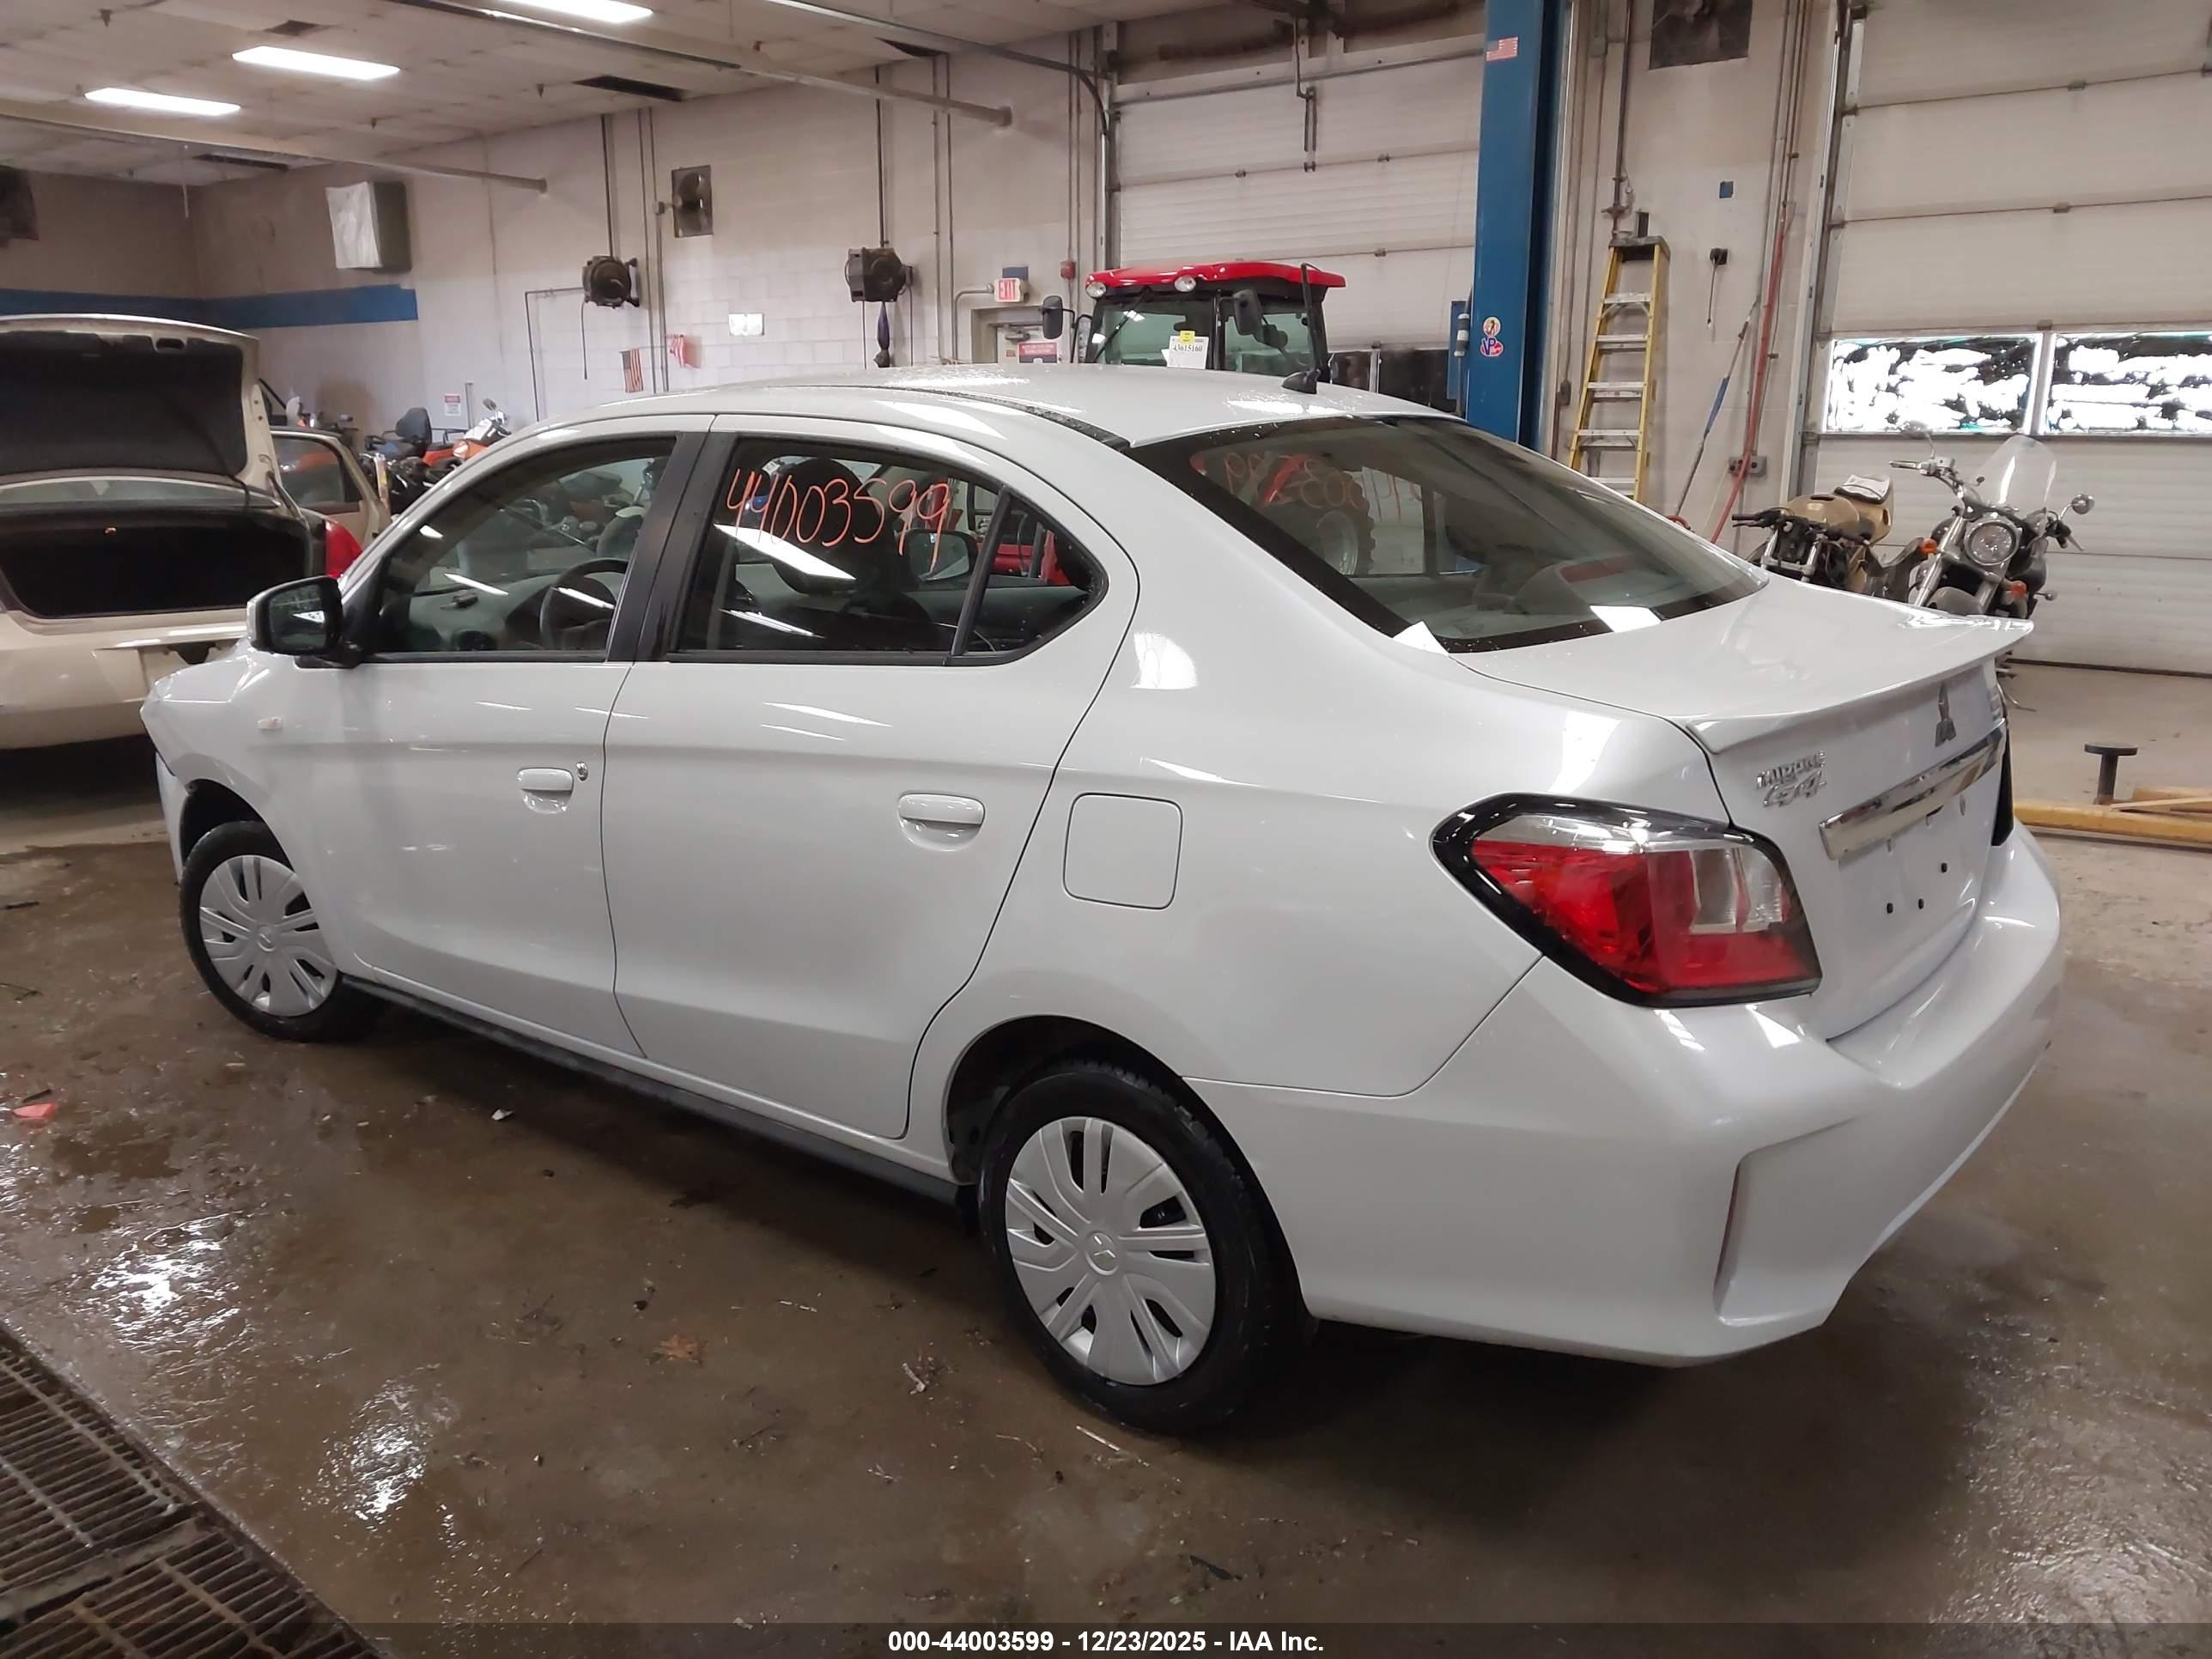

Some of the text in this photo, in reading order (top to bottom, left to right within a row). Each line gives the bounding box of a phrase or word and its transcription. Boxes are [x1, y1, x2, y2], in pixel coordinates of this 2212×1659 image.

[999, 280, 1017, 300] EXIT
[1482, 337, 1497, 356] VP
[727, 468, 949, 573] 44003599
